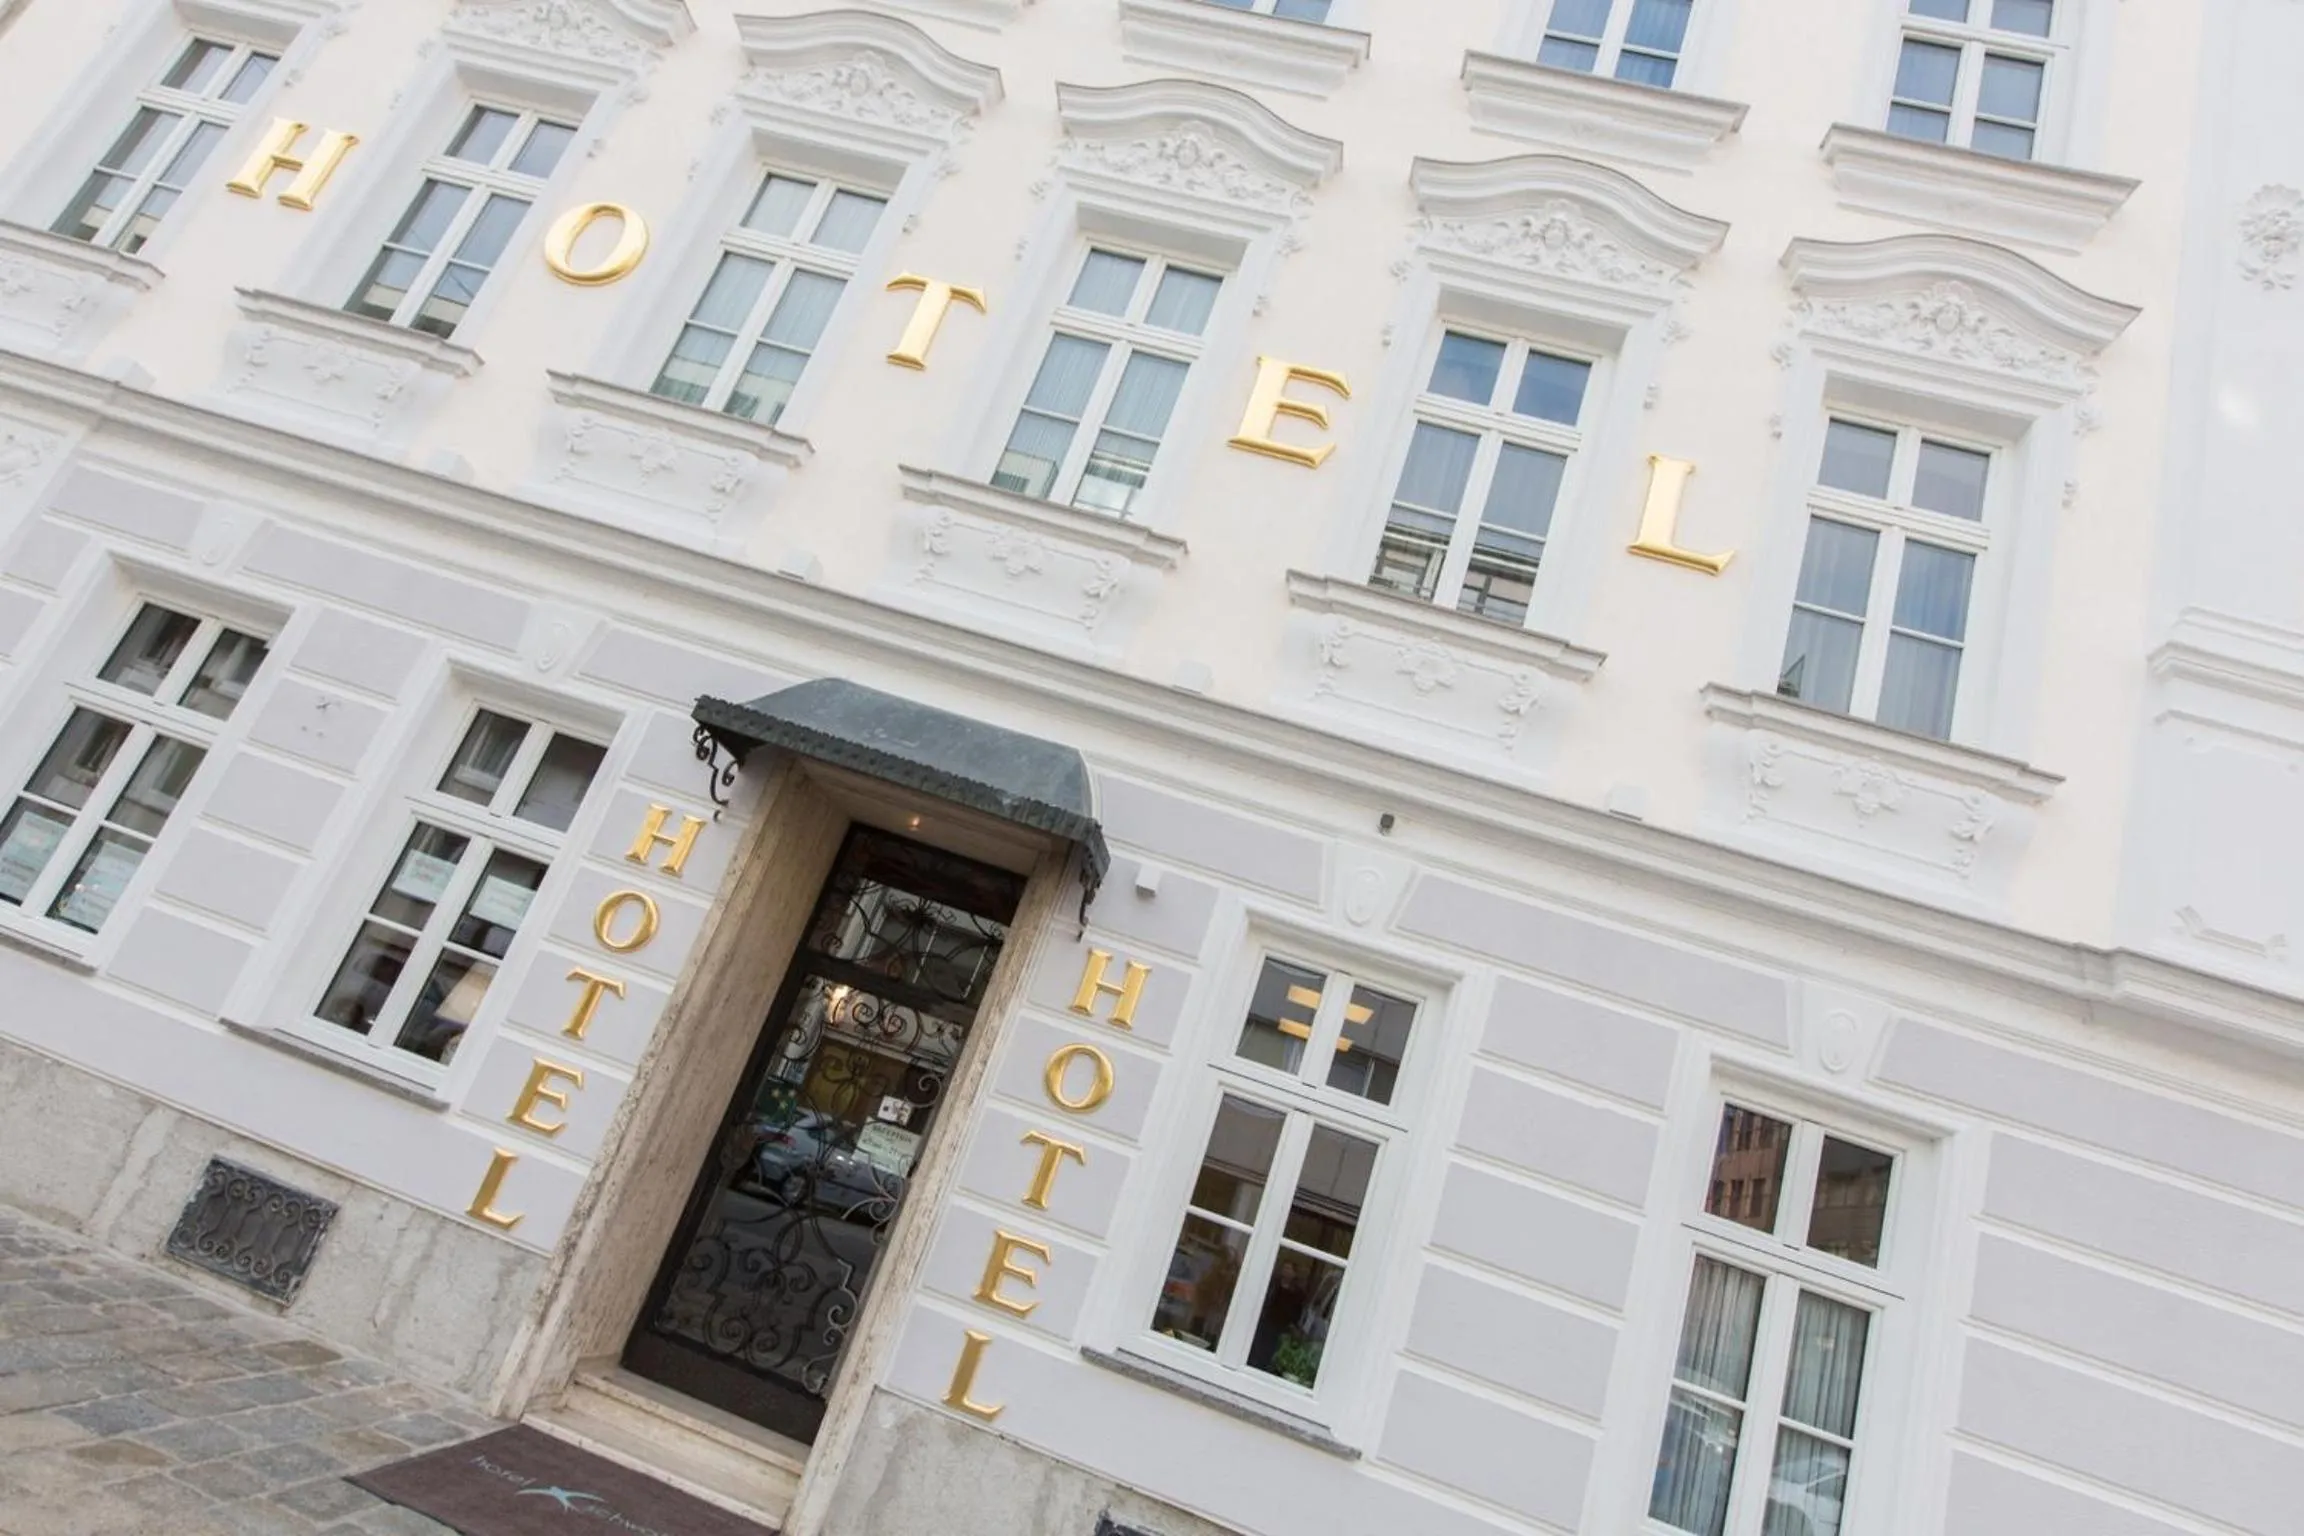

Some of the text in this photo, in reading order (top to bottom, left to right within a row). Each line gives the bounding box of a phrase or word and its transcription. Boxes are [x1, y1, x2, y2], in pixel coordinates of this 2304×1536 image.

[226, 116, 1736, 577] HOTEL
[466, 802, 707, 1230] HOTEL
[941, 946, 1151, 1422] HOTEL
[470, 1455, 537, 1487] hotel
